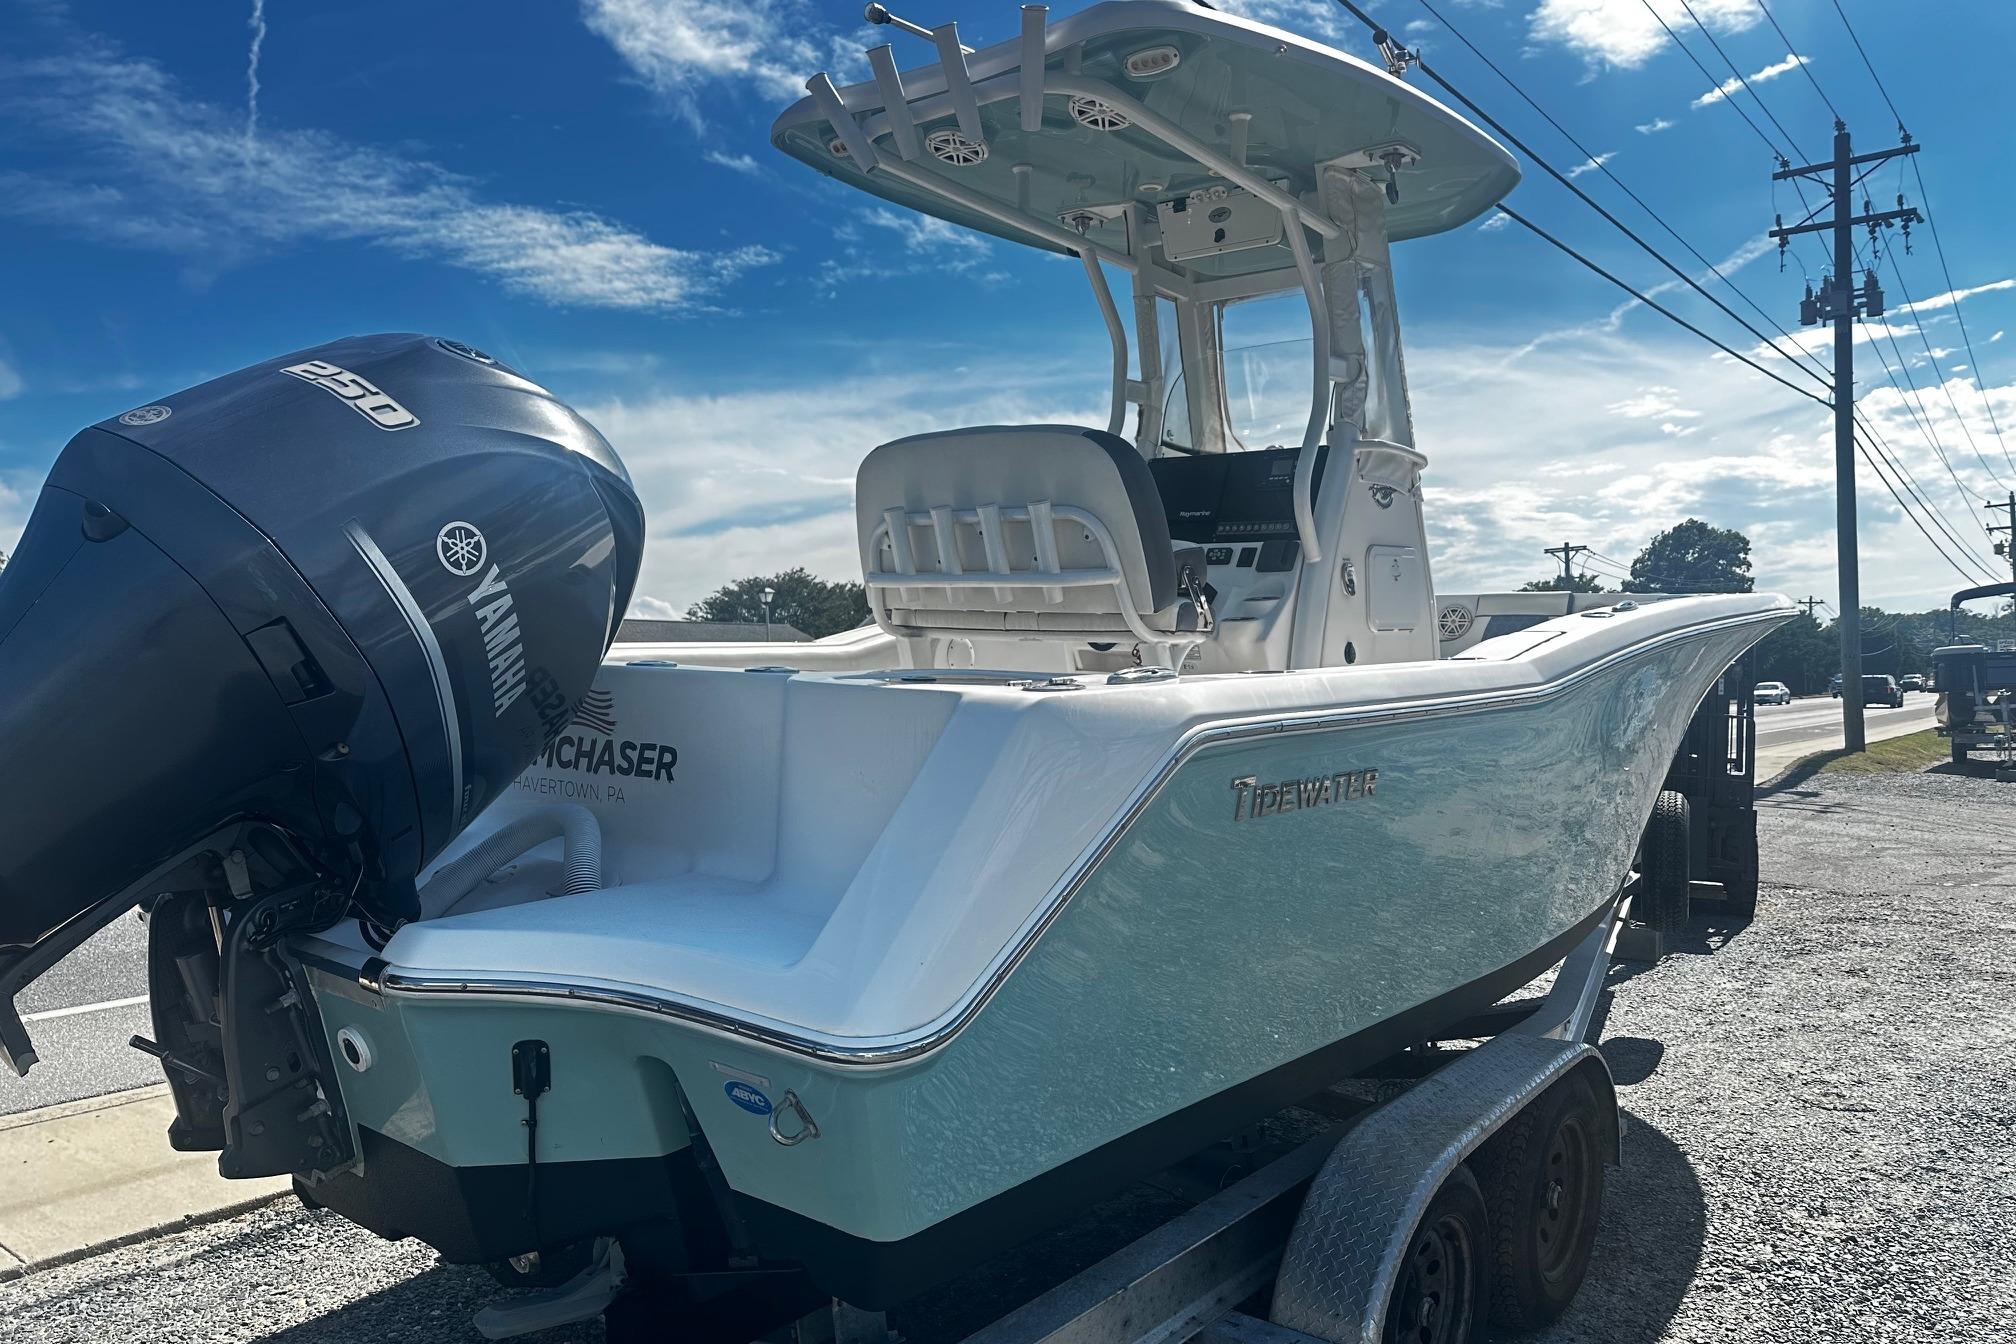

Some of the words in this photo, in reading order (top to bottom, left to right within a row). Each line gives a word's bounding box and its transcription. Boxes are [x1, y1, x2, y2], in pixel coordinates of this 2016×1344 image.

[281, 360, 418, 430] 250
[1180, 510, 1211, 518] Raymarine
[467, 563, 527, 718] YAMAHA
[607, 785, 626, 804] PA
[1231, 767, 1379, 822] TIDEWATER
[731, 1087, 765, 1107] ABYC
